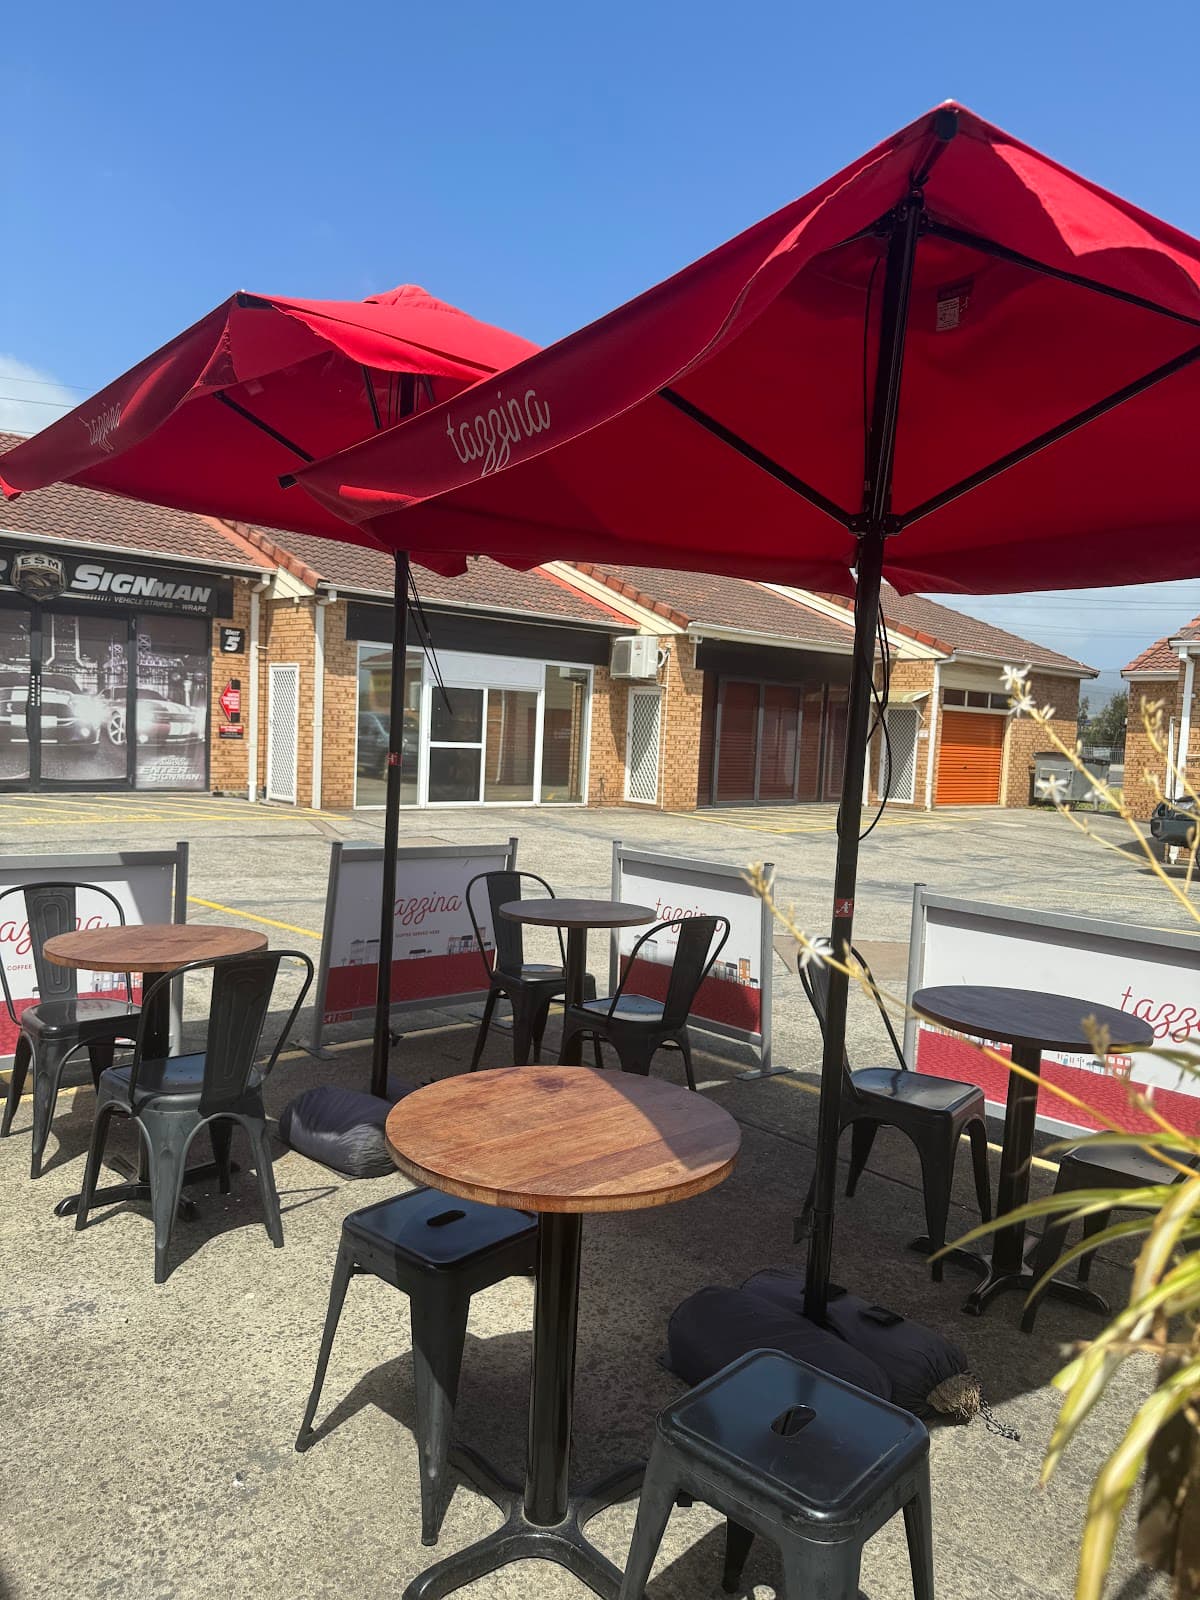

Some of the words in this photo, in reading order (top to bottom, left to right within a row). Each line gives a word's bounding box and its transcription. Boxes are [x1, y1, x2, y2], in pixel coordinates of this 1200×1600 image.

[446, 390, 551, 477] tazzina
[21, 557, 60, 569] ESM
[224, 636, 241, 651] 5
[393, 891, 461, 925] azzina
[7, 963, 33, 971] COFFEE
